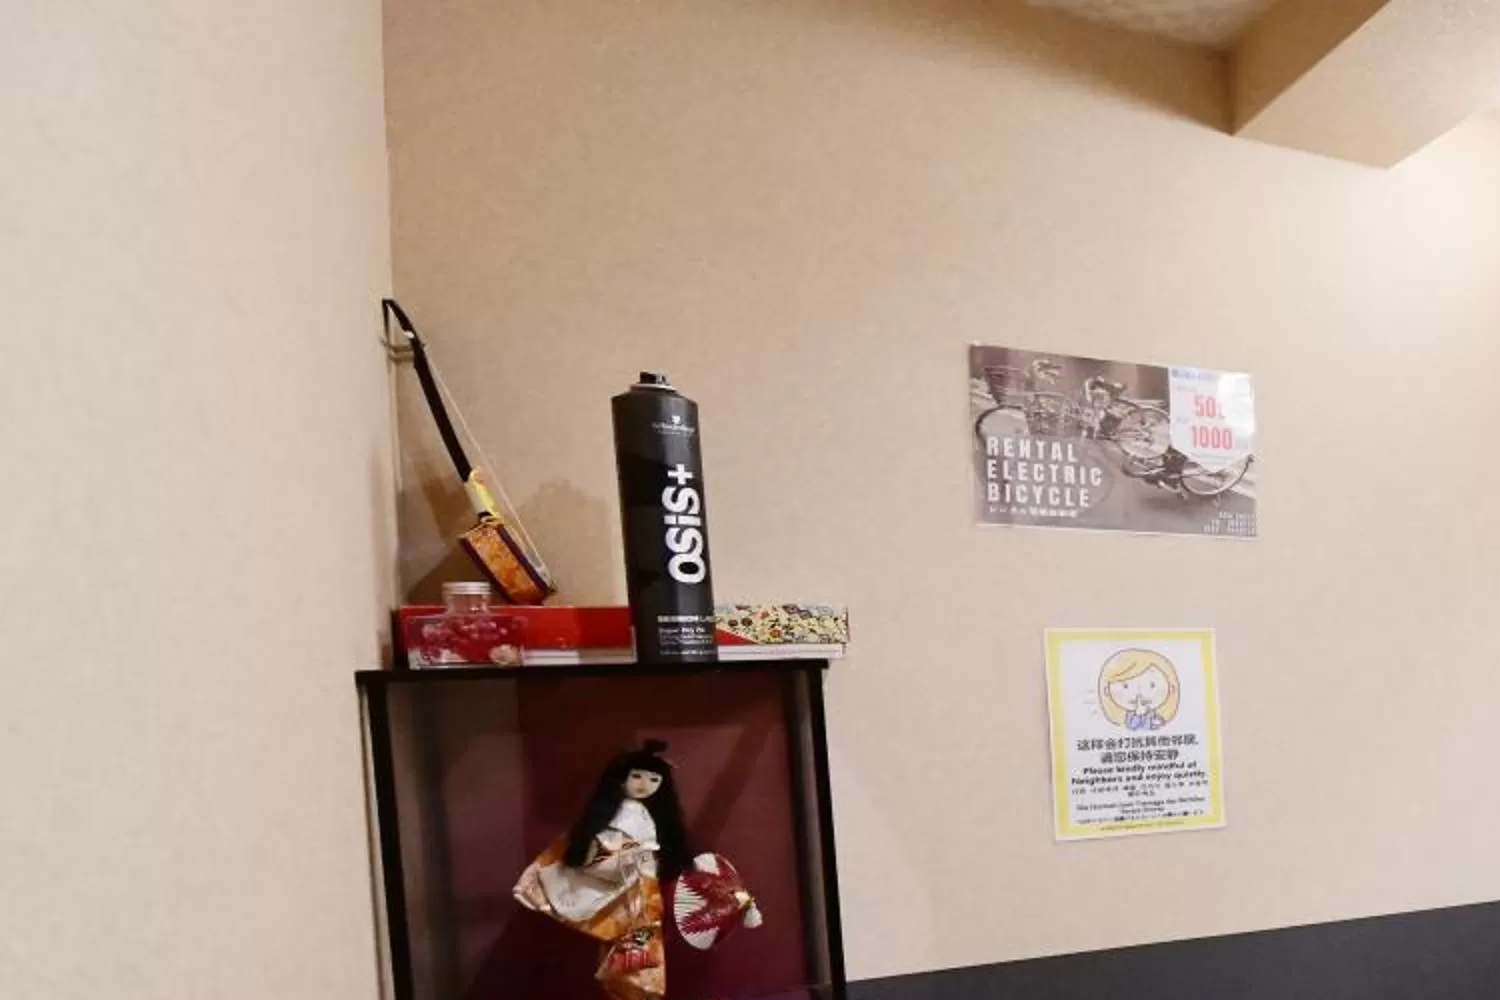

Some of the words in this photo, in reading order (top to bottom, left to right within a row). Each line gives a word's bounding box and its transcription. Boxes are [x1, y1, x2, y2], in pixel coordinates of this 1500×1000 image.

[986, 436, 1078, 463] RENTAL
[1191, 425, 1233, 449] 1000
[986, 459, 1103, 487] ELECTRIC
[987, 482, 1089, 508] BICYCLE
[1116, 764, 1145, 774] kindly
[1187, 760, 1197, 769] of
[1125, 773, 1143, 781] and
